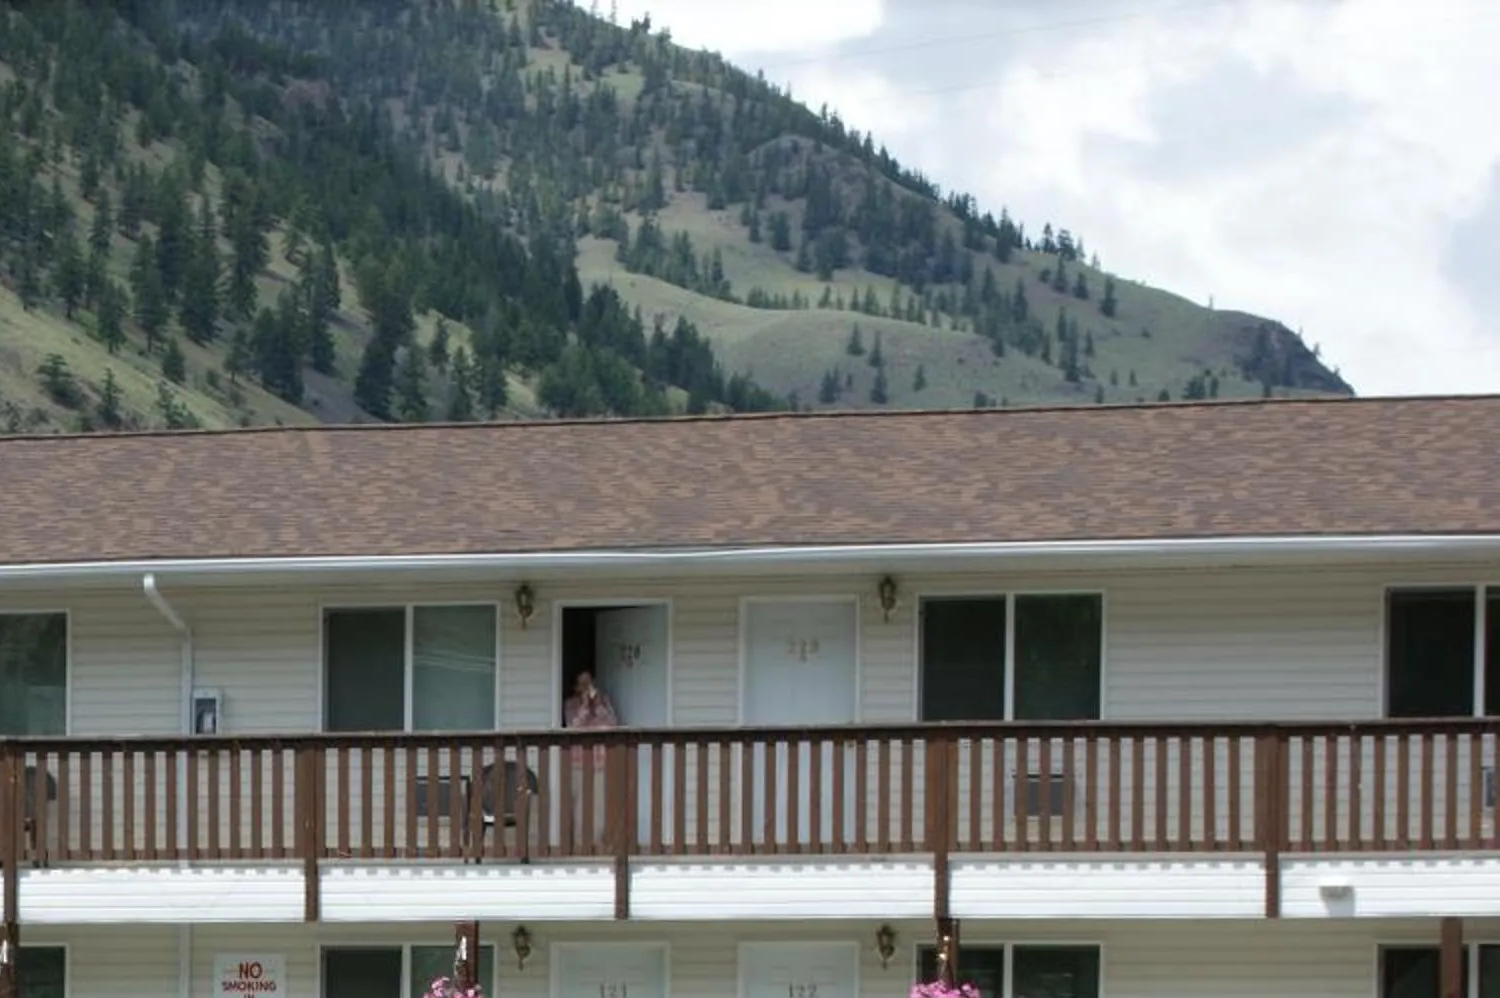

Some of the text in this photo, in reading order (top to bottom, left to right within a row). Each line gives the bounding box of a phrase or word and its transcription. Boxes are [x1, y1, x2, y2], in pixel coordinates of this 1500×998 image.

[239, 962, 262, 979] NO
[222, 981, 276, 992] SMOKING
[788, 983, 818, 998] 122
